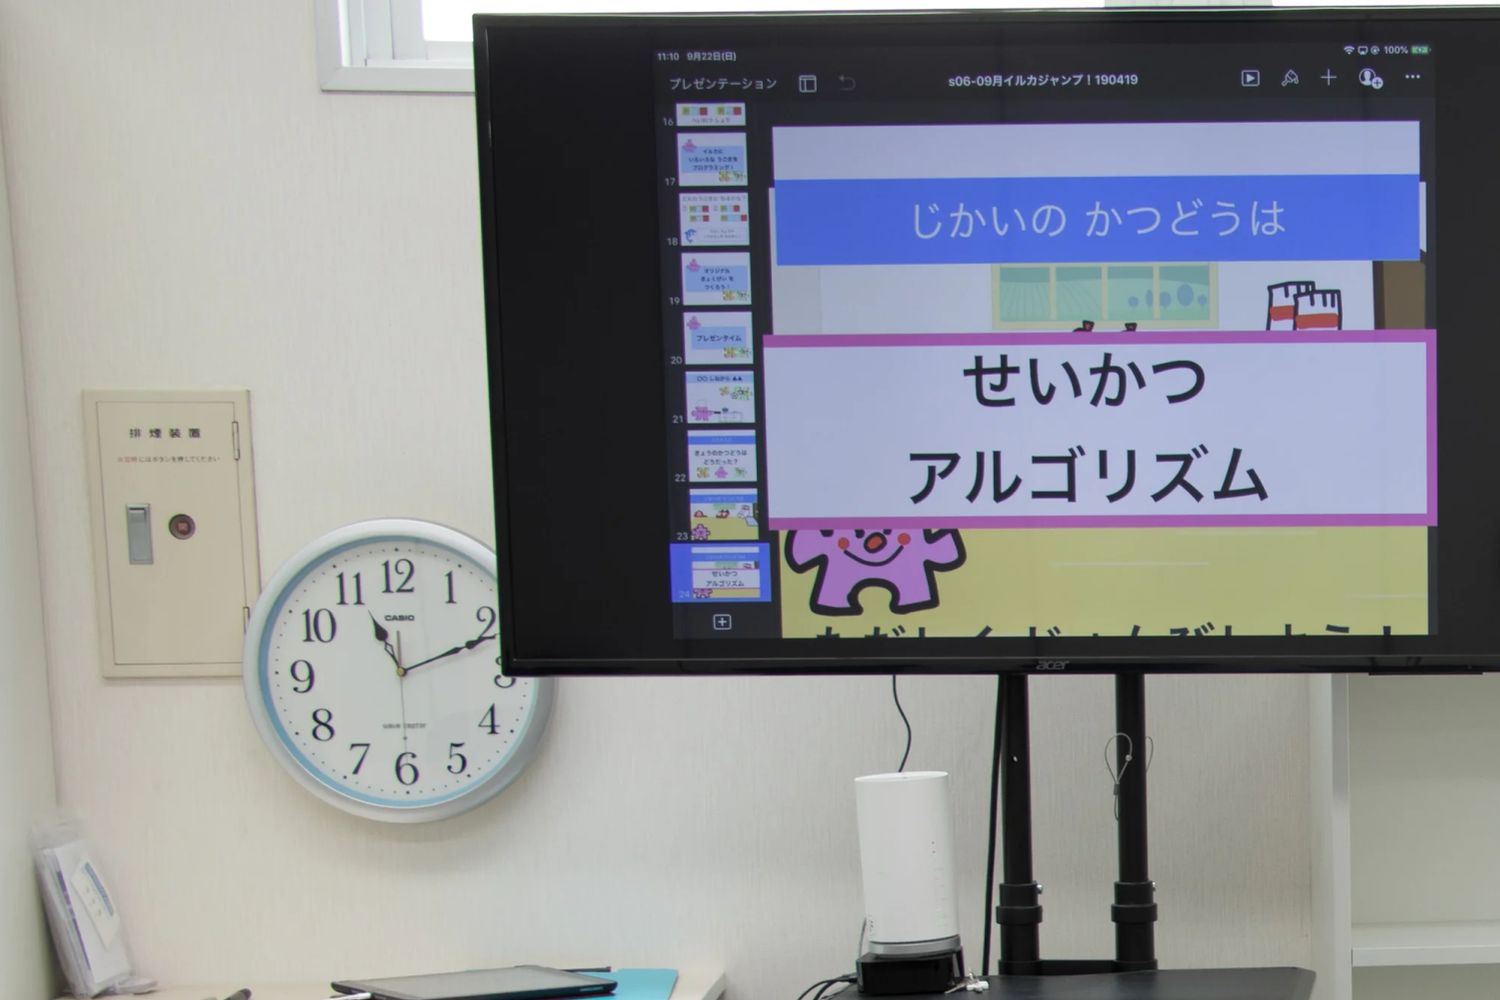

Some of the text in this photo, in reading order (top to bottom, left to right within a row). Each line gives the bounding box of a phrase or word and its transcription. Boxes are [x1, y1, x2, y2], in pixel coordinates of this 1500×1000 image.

[657, 52, 680, 61] 11:10
[1384, 45, 1408, 54] 100%
[670, 77, 777, 91] プレゼンテーション
[662, 117, 674, 127] 16
[664, 177, 676, 187] 17
[913, 197, 1287, 240] じかいの かつどうは
[667, 236, 679, 247] 18
[668, 296, 680, 306] 19
[670, 355, 683, 365] 20
[963, 351, 1207, 408] せいかつ
[672, 414, 684, 424] 21
[674, 473, 687, 483] 22
[909, 443, 1270, 505] アルゴリズム
[676, 531, 689, 541] 23
[381, 558, 415, 594] 12
[712, 570, 739, 578] せいかつ
[336, 571, 366, 606] 11
[444, 570, 457, 604] 1
[706, 580, 745, 588] アルゴリズム
[384, 614, 415, 622] CASIO
[476, 605, 497, 640] 2
[302, 607, 338, 644] 10
[1036, 660, 1071, 671] acer
[290, 659, 316, 694] 9
[311, 707, 336, 743] 8
[477, 703, 501, 736] 4
[349, 742, 372, 776] 7
[446, 742, 468, 775] 5
[395, 751, 420, 786] 6
